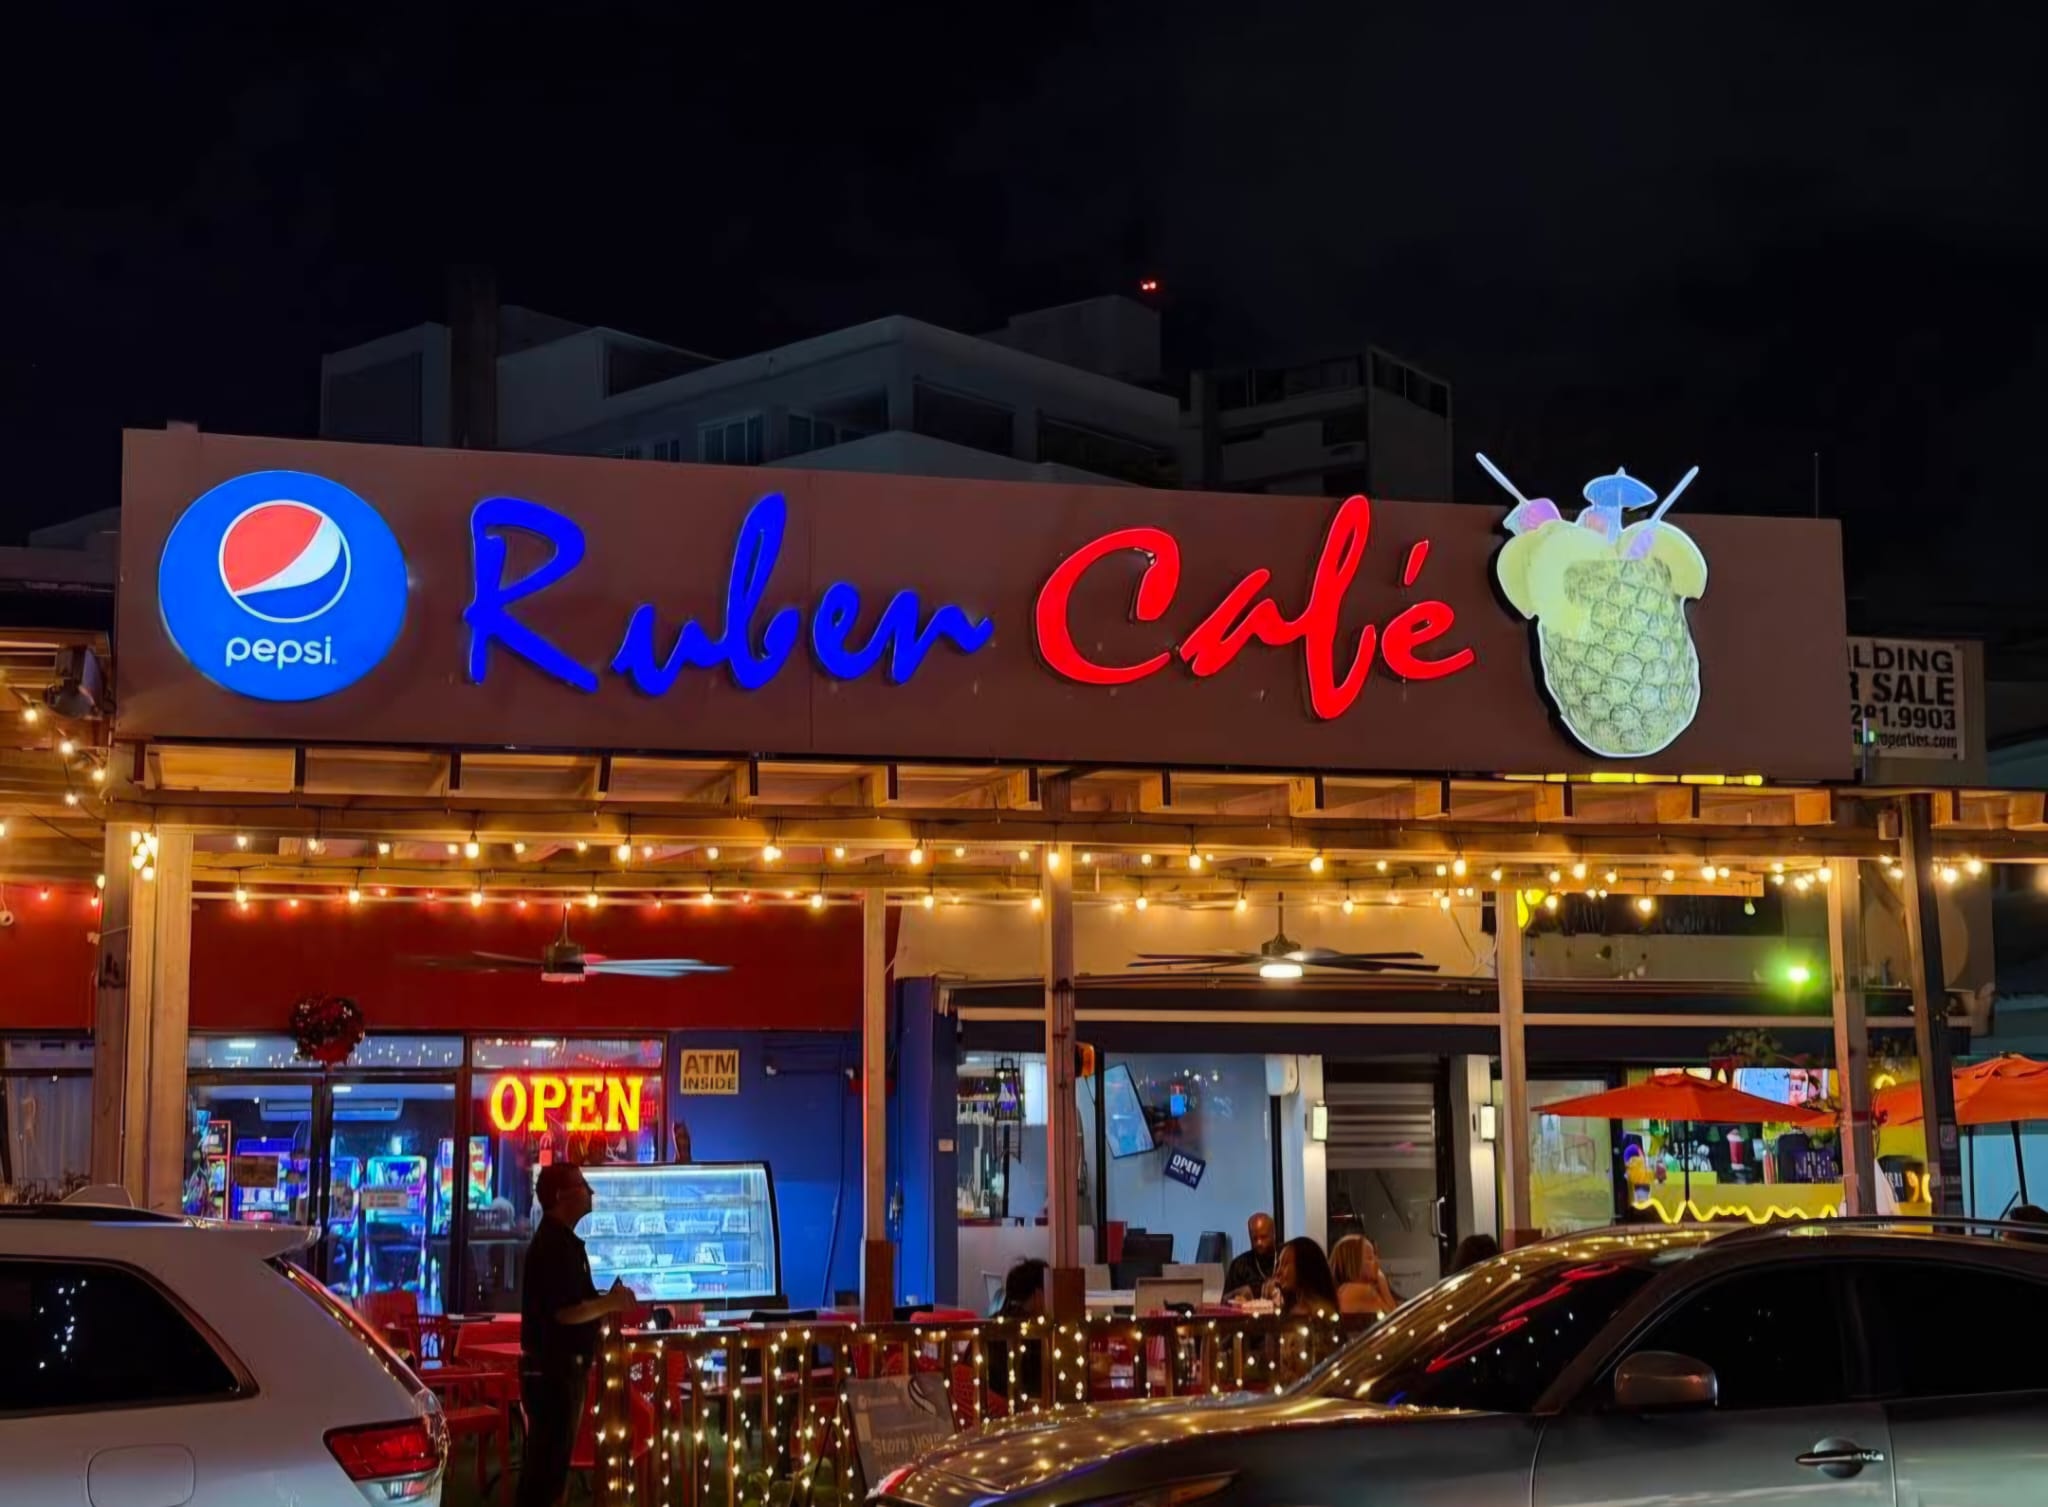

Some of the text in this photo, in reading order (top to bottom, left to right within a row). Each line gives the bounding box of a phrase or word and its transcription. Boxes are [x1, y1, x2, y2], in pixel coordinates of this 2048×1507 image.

[463, 492, 1475, 719] Ruben Café
[225, 634, 331, 668] pepsi
[1847, 644, 1954, 674] LDING
[1872, 671, 1955, 706] SALE
[684, 1051, 736, 1075] ATM
[683, 1077, 736, 1090] INSIDE
[489, 1074, 645, 1133] OPEN
